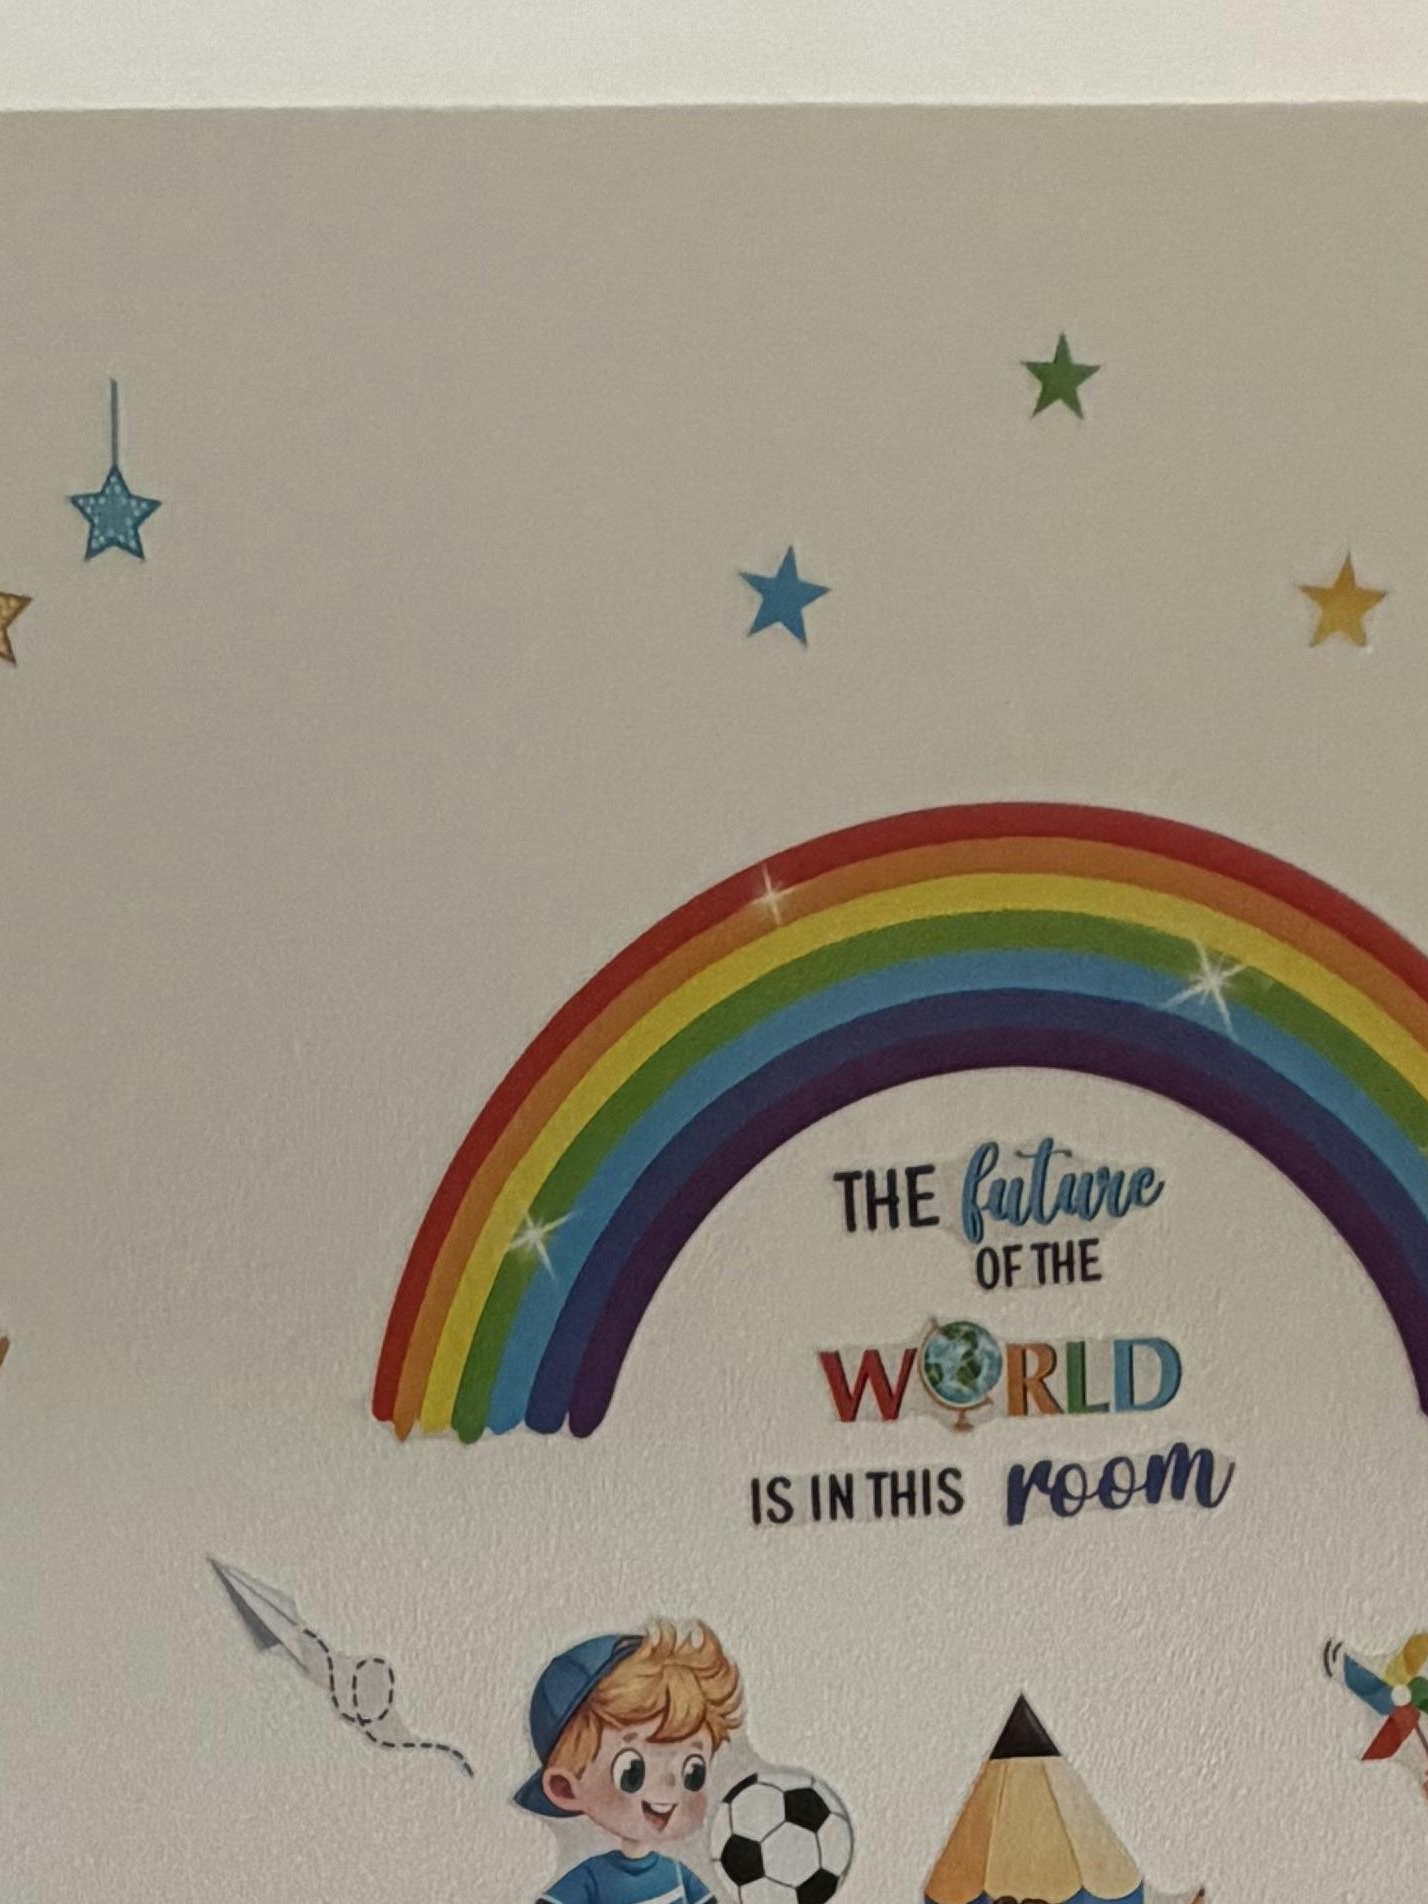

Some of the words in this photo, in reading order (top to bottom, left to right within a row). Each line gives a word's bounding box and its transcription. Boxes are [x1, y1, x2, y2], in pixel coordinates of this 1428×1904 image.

[833, 1164, 940, 1233] THE
[961, 1137, 1166, 1245] future
[976, 1244, 1023, 1291] OF
[1030, 1237, 1103, 1286] THE
[751, 1475, 795, 1525] IS
[810, 1472, 855, 1522] IN
[866, 1466, 965, 1518] THIS
[1006, 1441, 1237, 1526] room
